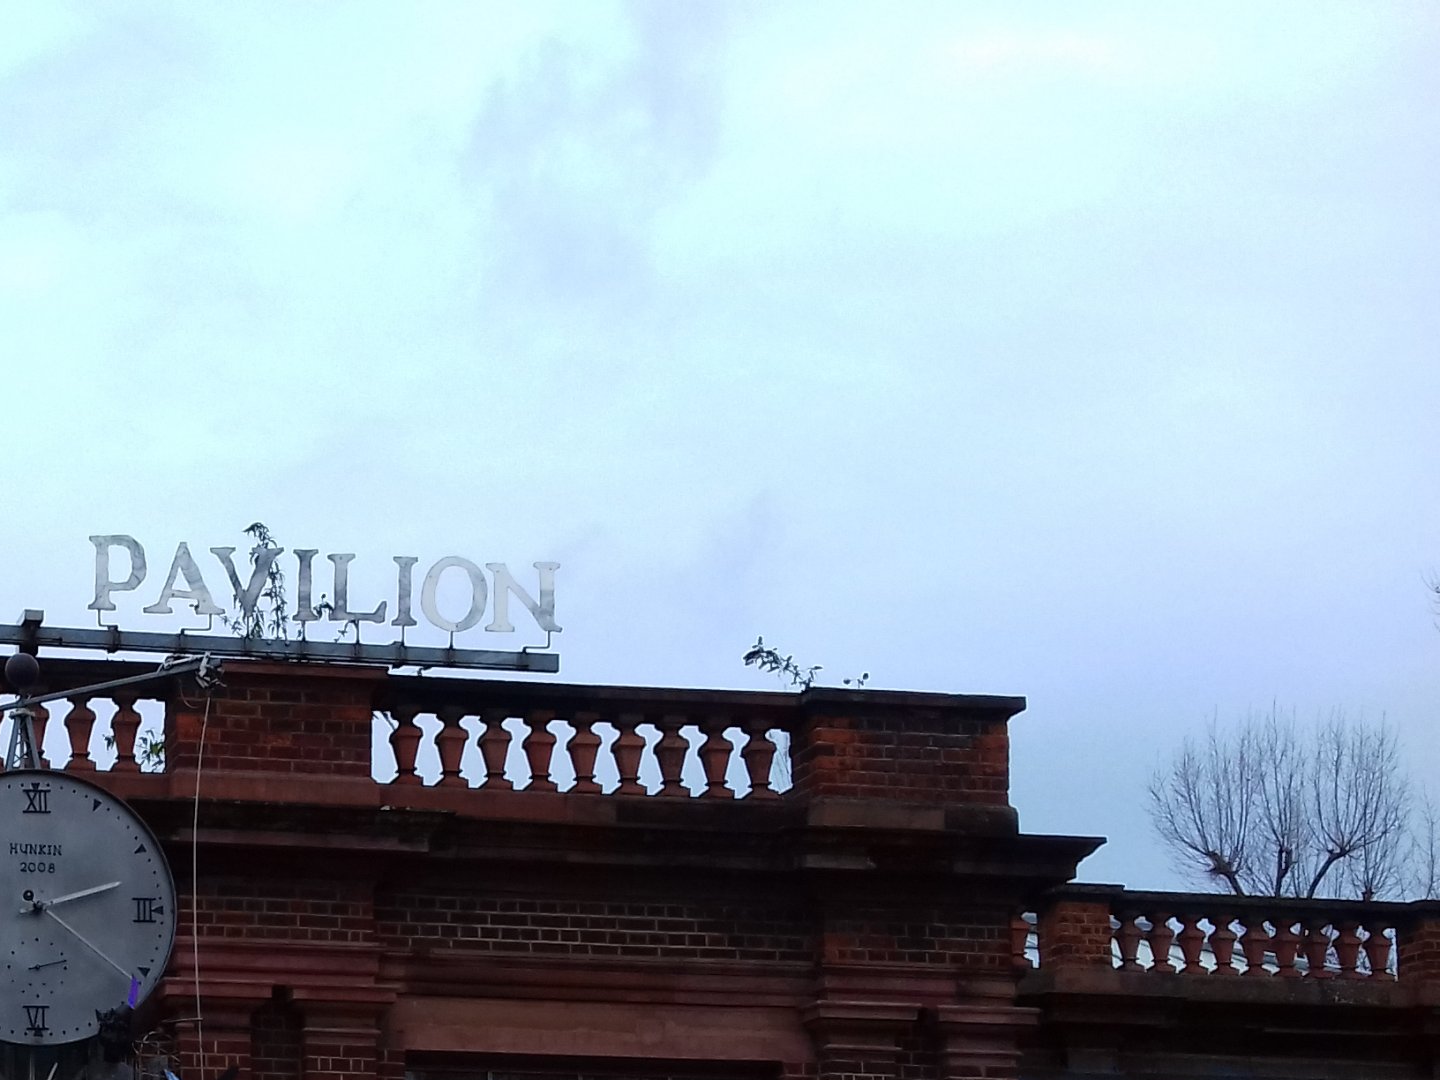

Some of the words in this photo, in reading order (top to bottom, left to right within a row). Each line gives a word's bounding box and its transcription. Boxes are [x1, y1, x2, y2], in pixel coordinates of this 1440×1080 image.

[88, 534, 563, 633] PAVILION
[22, 789, 51, 813] XII
[9, 842, 63, 856] HUNKIN
[19, 861, 56, 874] 2008
[132, 897, 157, 923] III
[22, 1005, 51, 1031] VI
